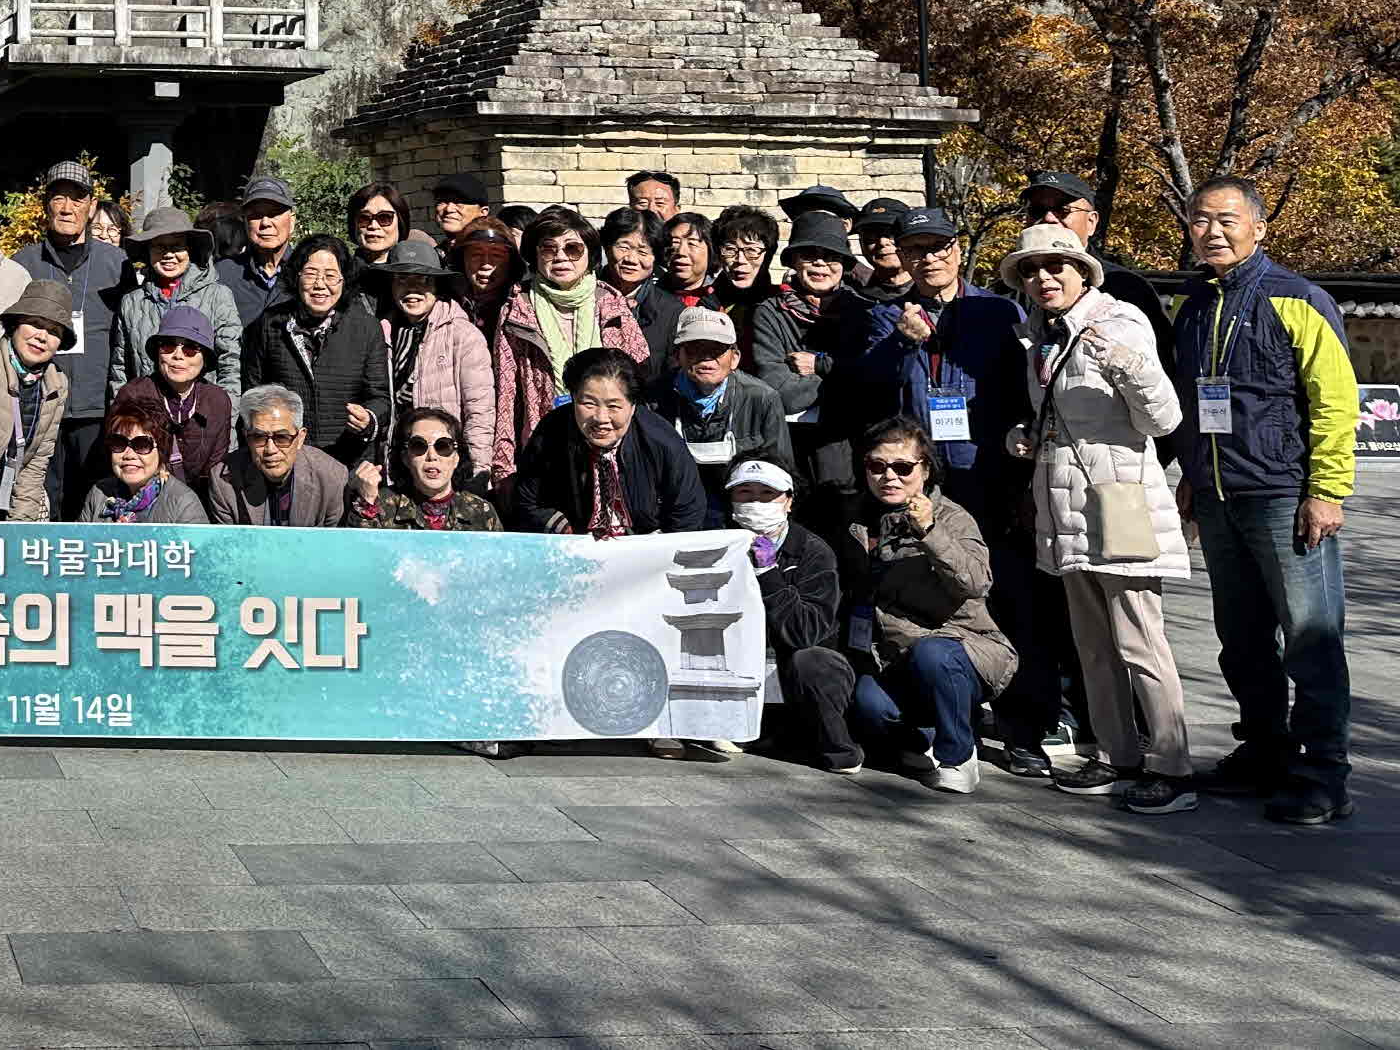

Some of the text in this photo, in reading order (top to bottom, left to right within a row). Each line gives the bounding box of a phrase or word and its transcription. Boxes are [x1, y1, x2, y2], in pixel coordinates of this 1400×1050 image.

[21, 538, 196, 578] 박물관대학
[93, 593, 220, 668] 맥을
[238, 596, 368, 669] 잇다
[6, 694, 61, 727] 11월
[70, 694, 134, 728] 14일
